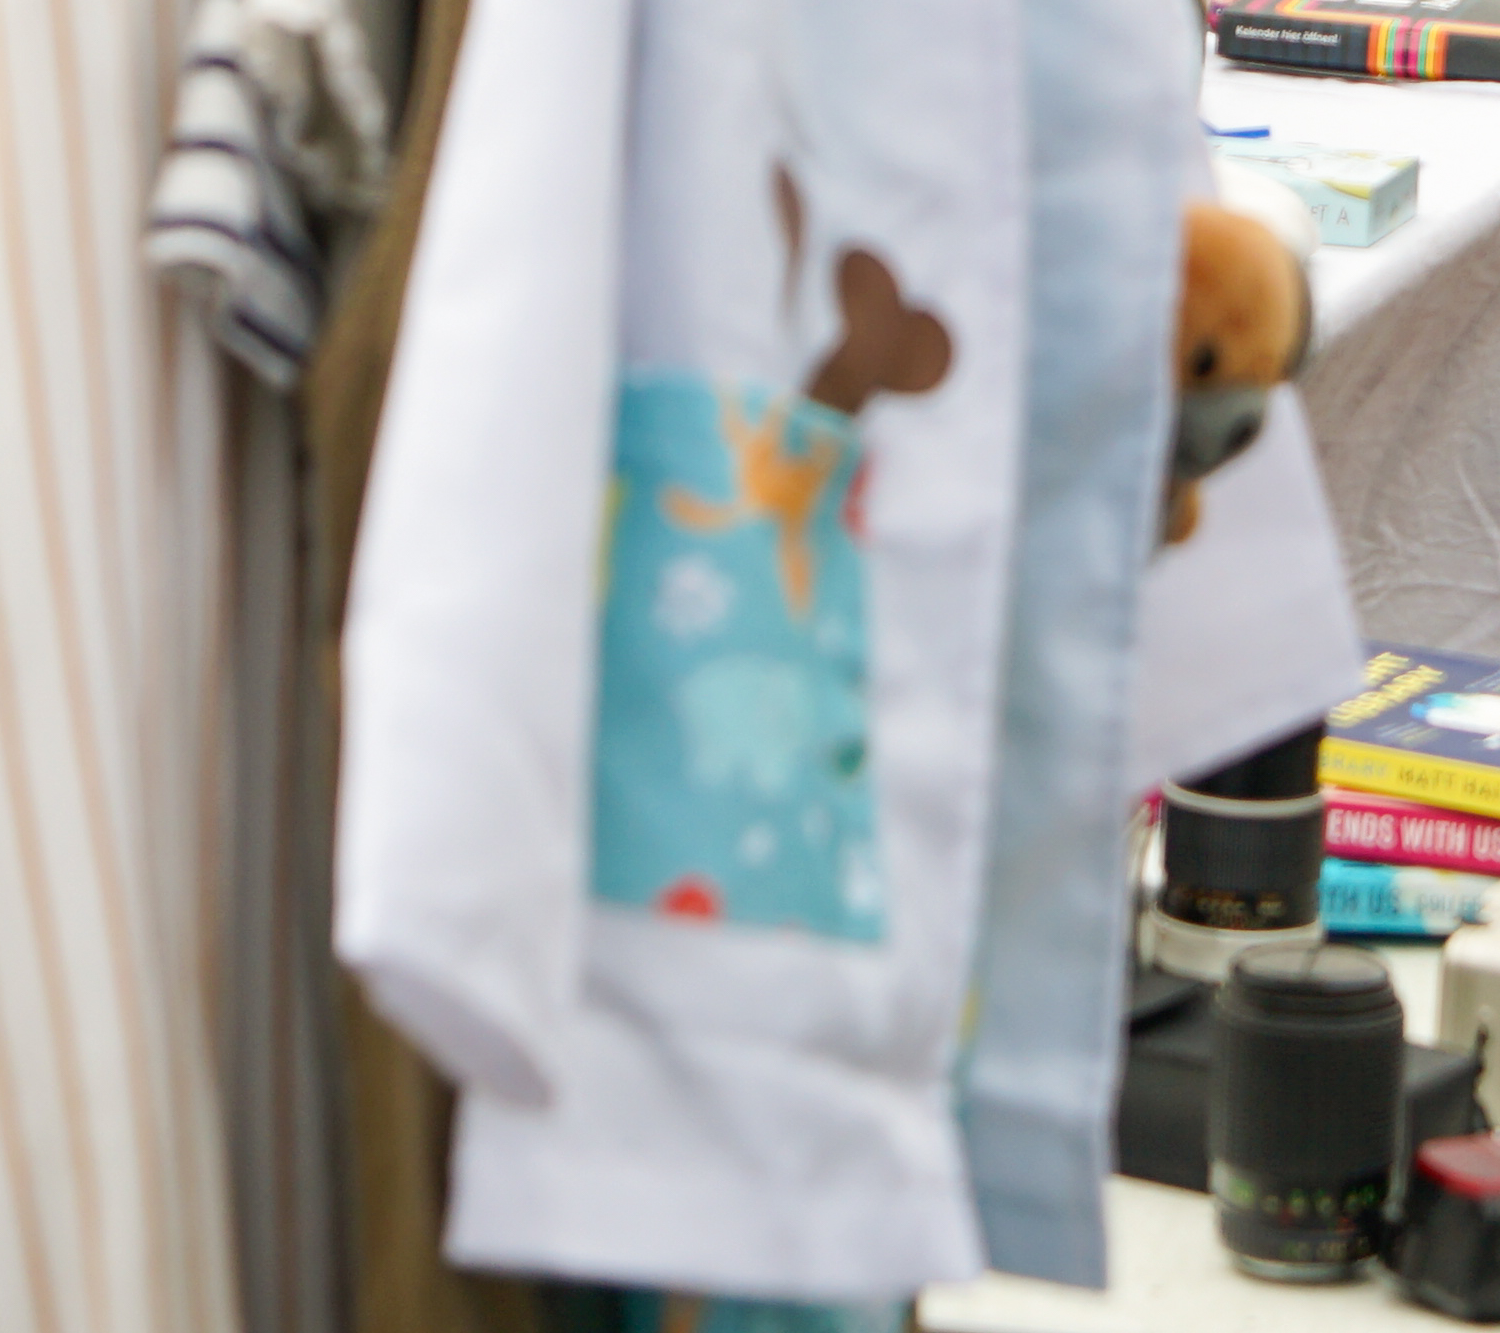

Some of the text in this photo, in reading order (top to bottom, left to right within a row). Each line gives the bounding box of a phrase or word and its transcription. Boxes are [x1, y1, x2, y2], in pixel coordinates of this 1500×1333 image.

[1281, 27, 1302, 41] hier
[1397, 767, 1455, 790] MATT
[1326, 808, 1396, 850] ENDS
[1400, 814, 1469, 857] WITH
